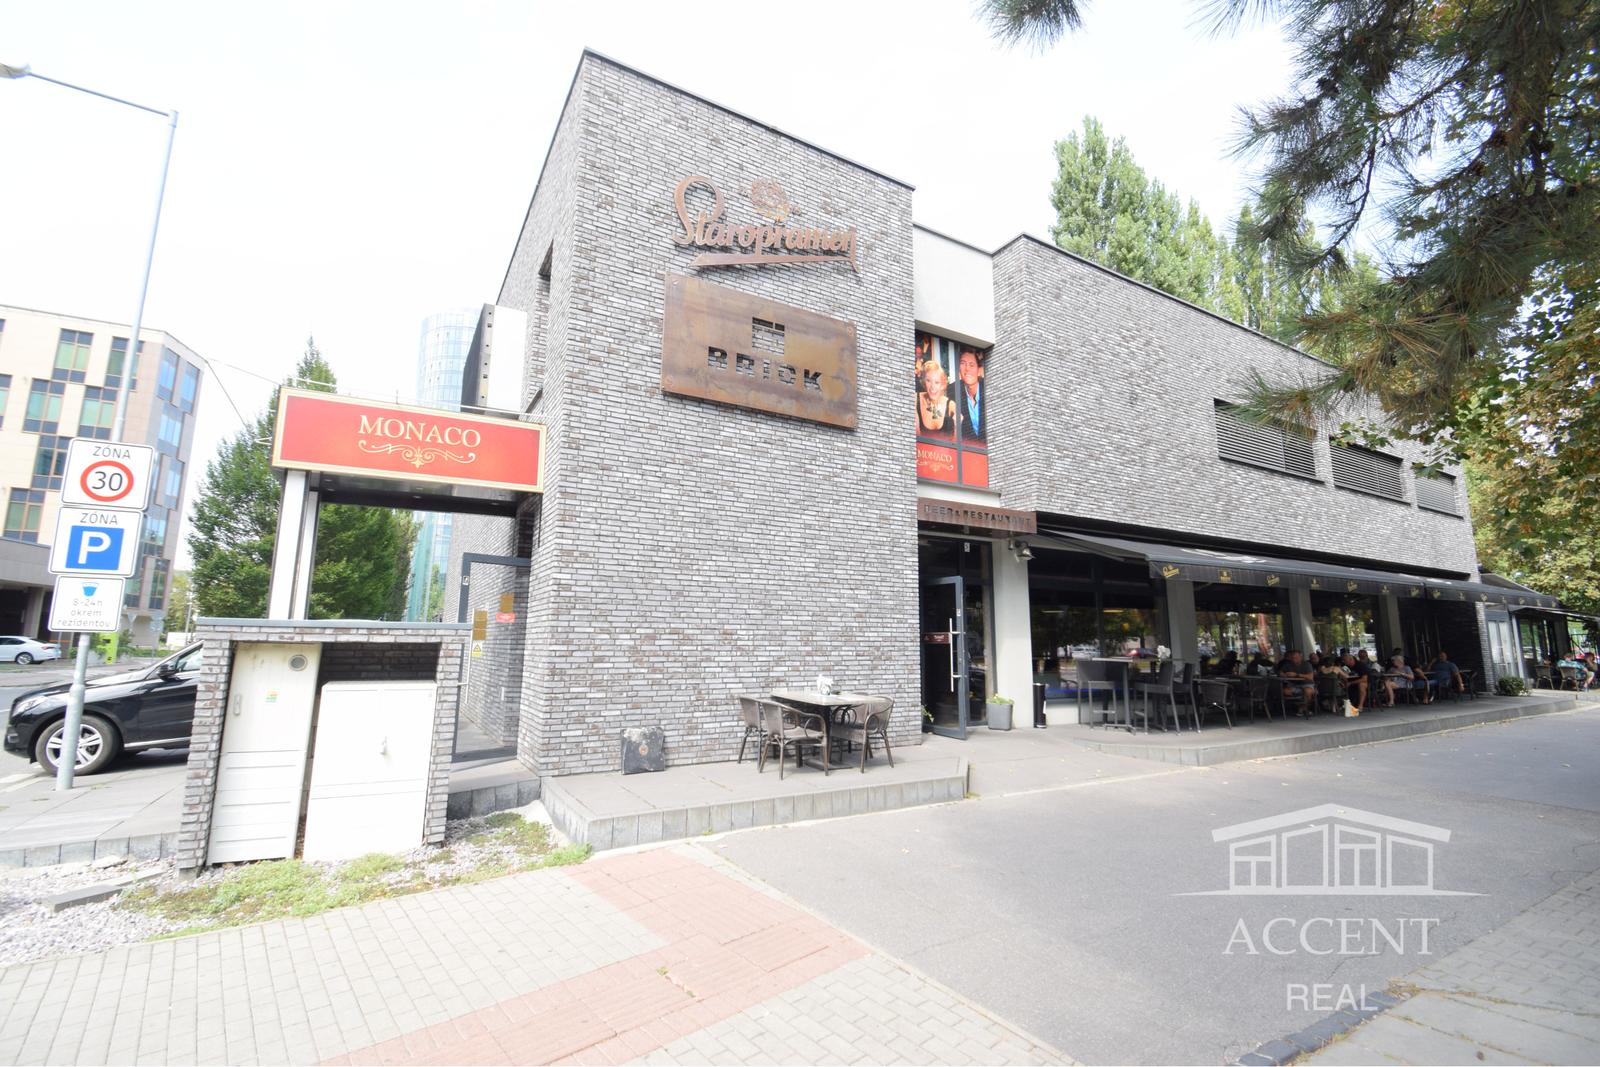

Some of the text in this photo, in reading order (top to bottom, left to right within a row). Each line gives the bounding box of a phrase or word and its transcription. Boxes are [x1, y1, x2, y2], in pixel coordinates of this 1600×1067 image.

[672, 175, 860, 274] Staropramen
[707, 346, 822, 392] BRICK
[358, 415, 481, 448] MONACO
[92, 445, 131, 460] ZÓNA
[917, 449, 953, 463] MONACO
[91, 471, 123, 492] 30
[80, 511, 118, 525] ZÓNA
[77, 530, 111, 564] P
